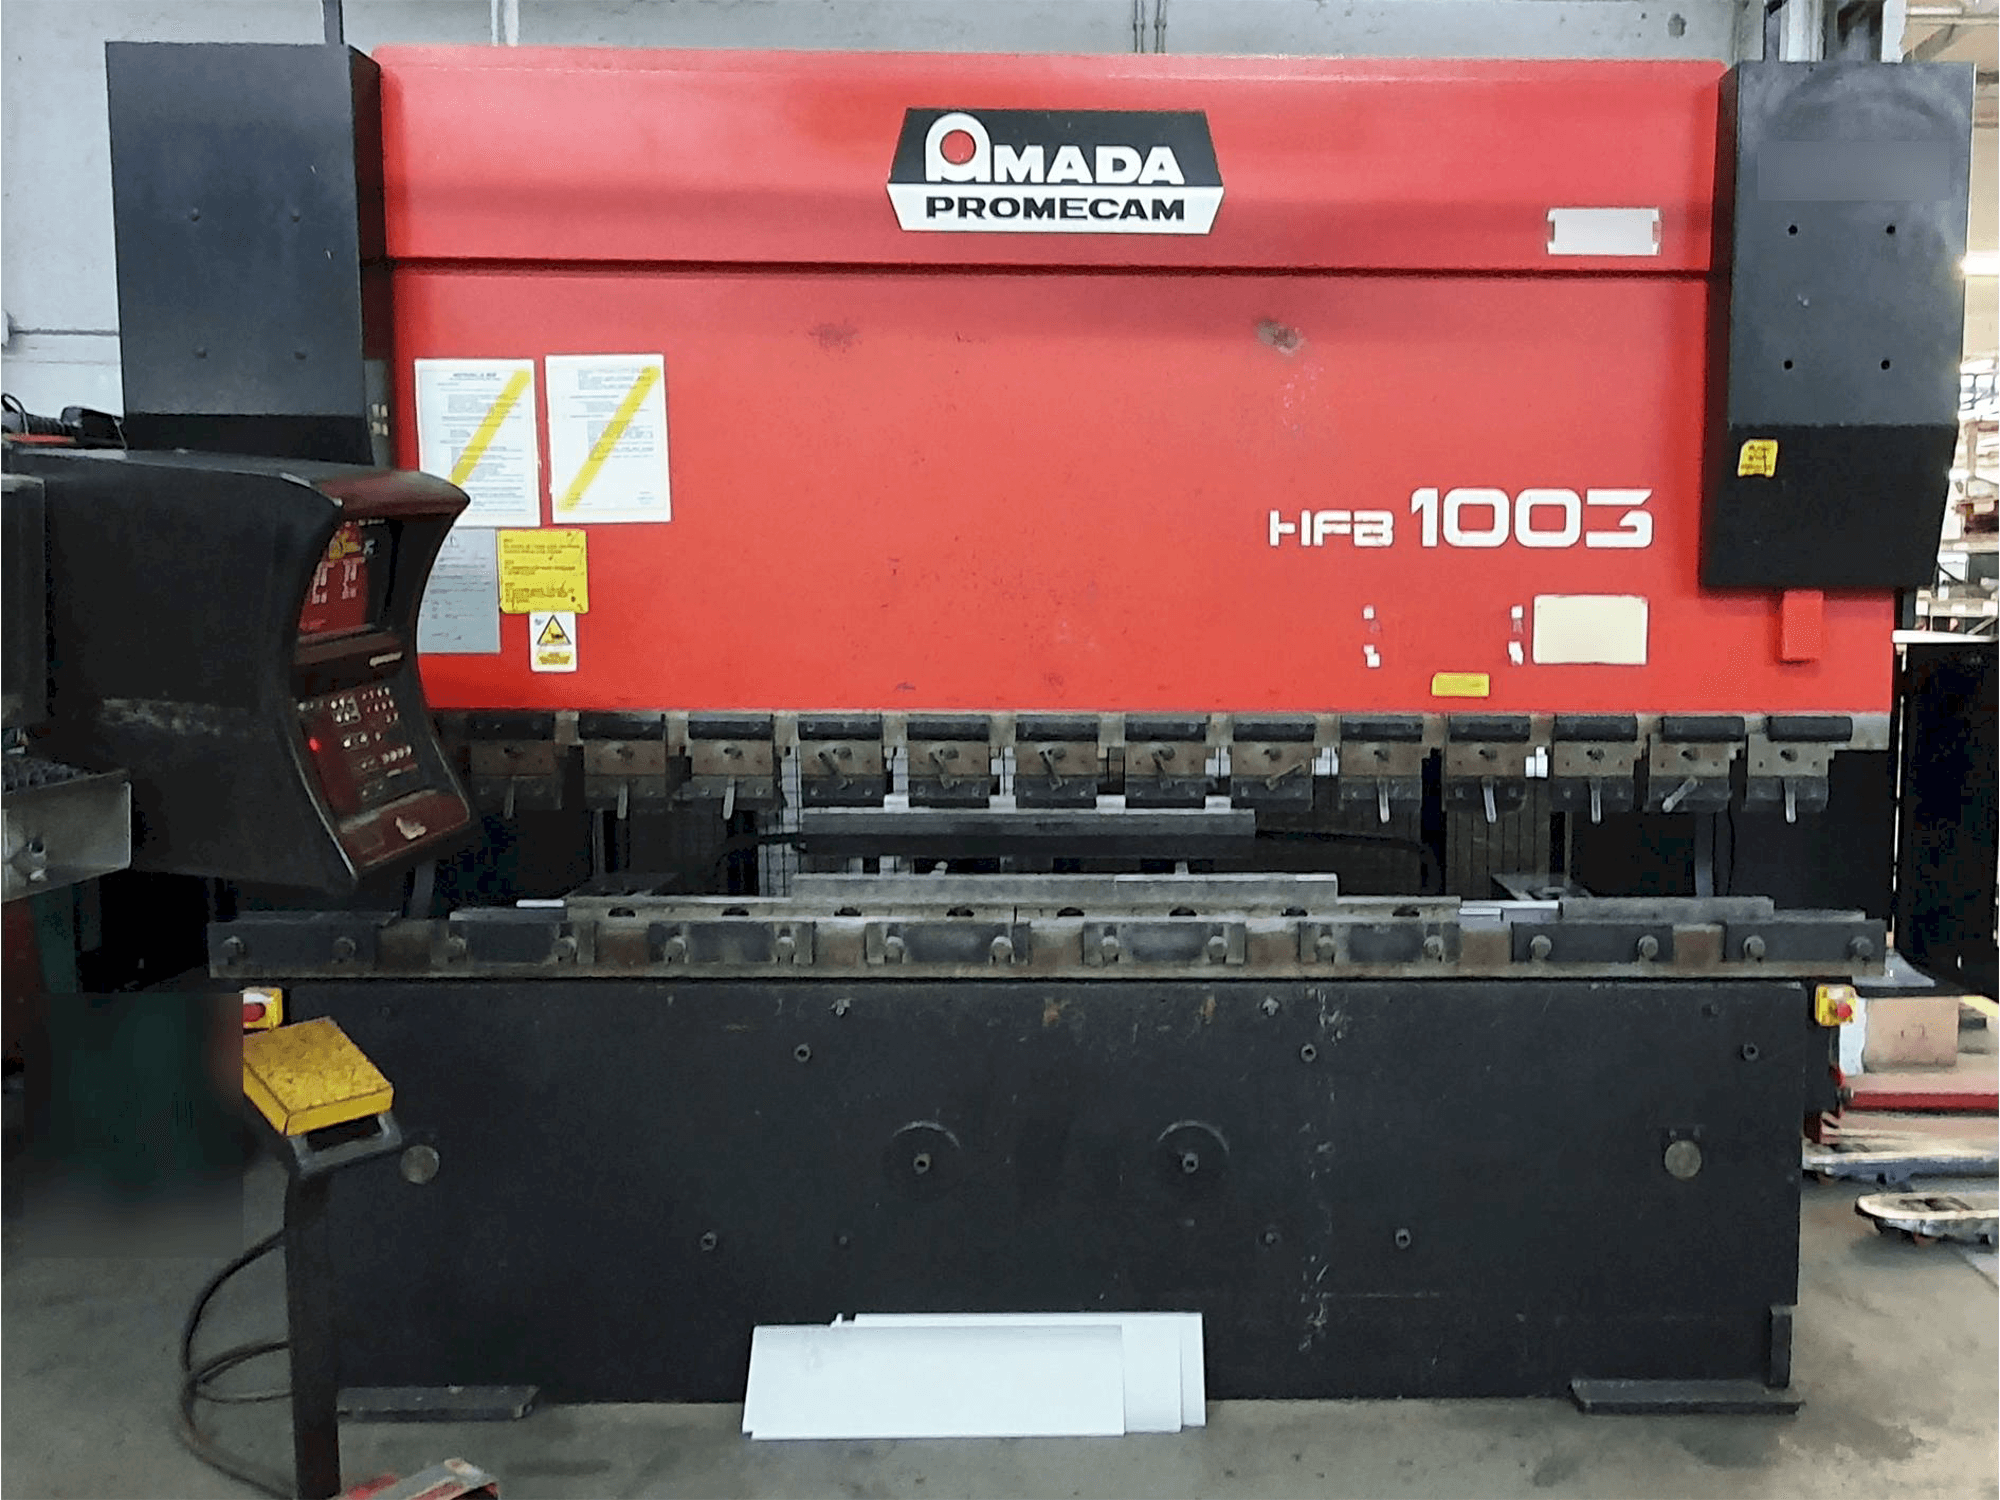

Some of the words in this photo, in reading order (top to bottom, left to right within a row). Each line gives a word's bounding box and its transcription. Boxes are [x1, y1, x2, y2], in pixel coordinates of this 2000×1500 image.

[925, 112, 1185, 185] AMADA
[926, 196, 1185, 221] PROMECAM
[1269, 510, 1394, 548] HFB
[1410, 486, 1654, 548] 1003
